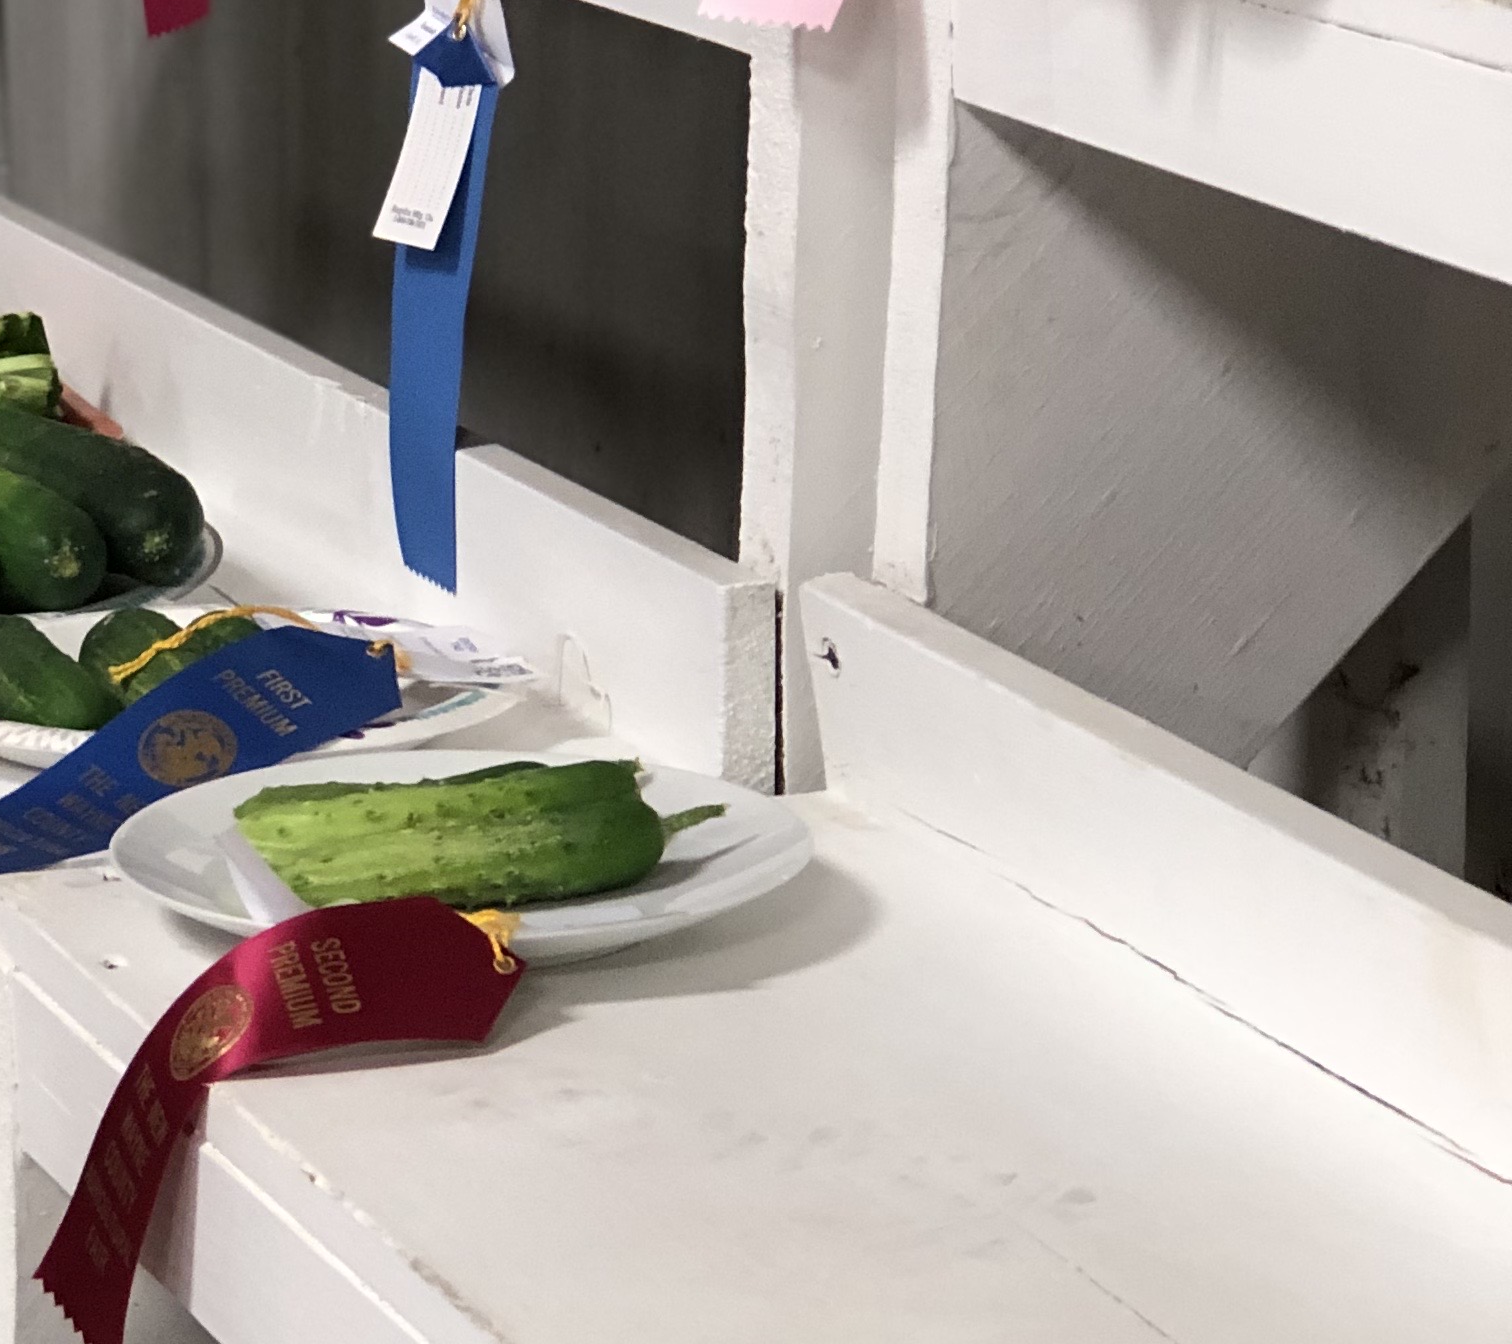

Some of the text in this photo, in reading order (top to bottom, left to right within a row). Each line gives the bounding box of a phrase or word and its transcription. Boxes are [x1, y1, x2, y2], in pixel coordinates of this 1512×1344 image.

[210, 668, 299, 737] PREMIUM
[255, 668, 313, 711] FIRST
[267, 939, 324, 1031] PREMIUM
[310, 937, 362, 1014] SECOND
